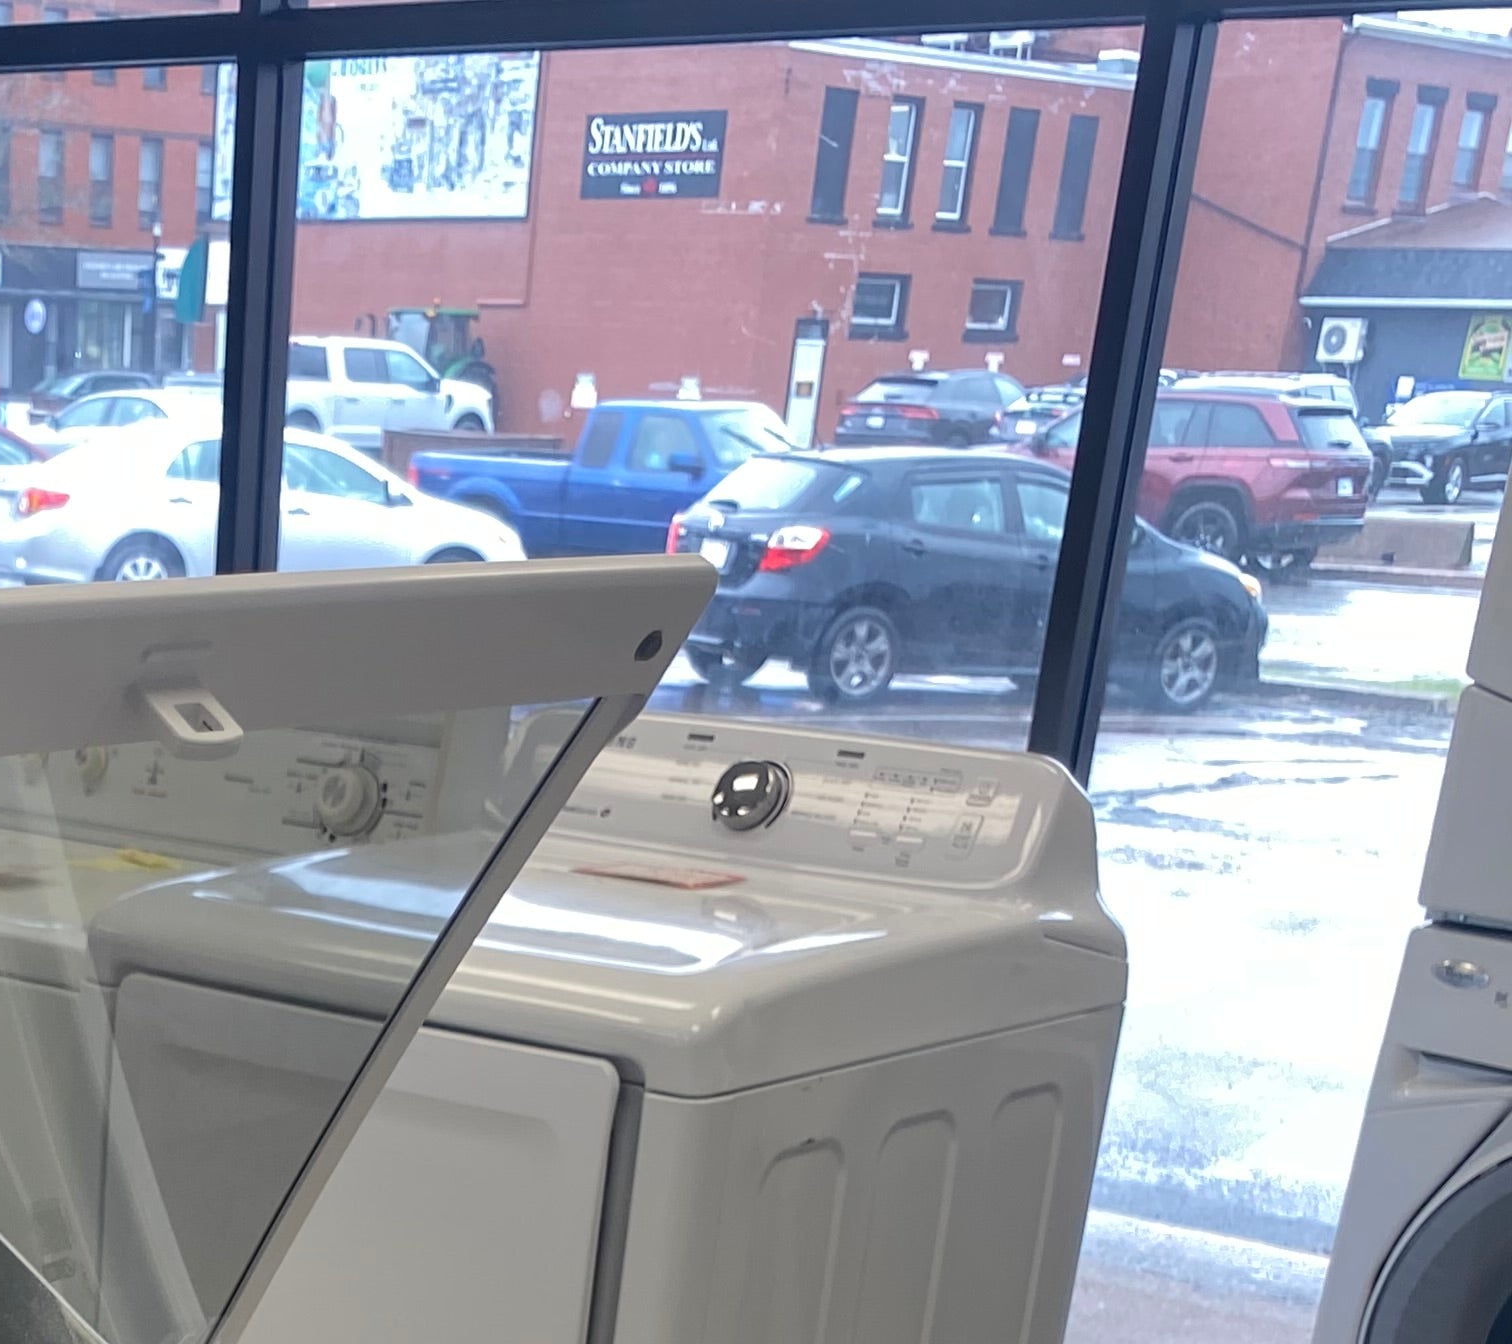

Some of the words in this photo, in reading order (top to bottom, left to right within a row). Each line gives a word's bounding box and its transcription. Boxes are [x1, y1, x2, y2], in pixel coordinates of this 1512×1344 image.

[588, 117, 704, 154] STANFIELD'S
[587, 160, 660, 177] COMPANY
[663, 160, 716, 174] STORE
